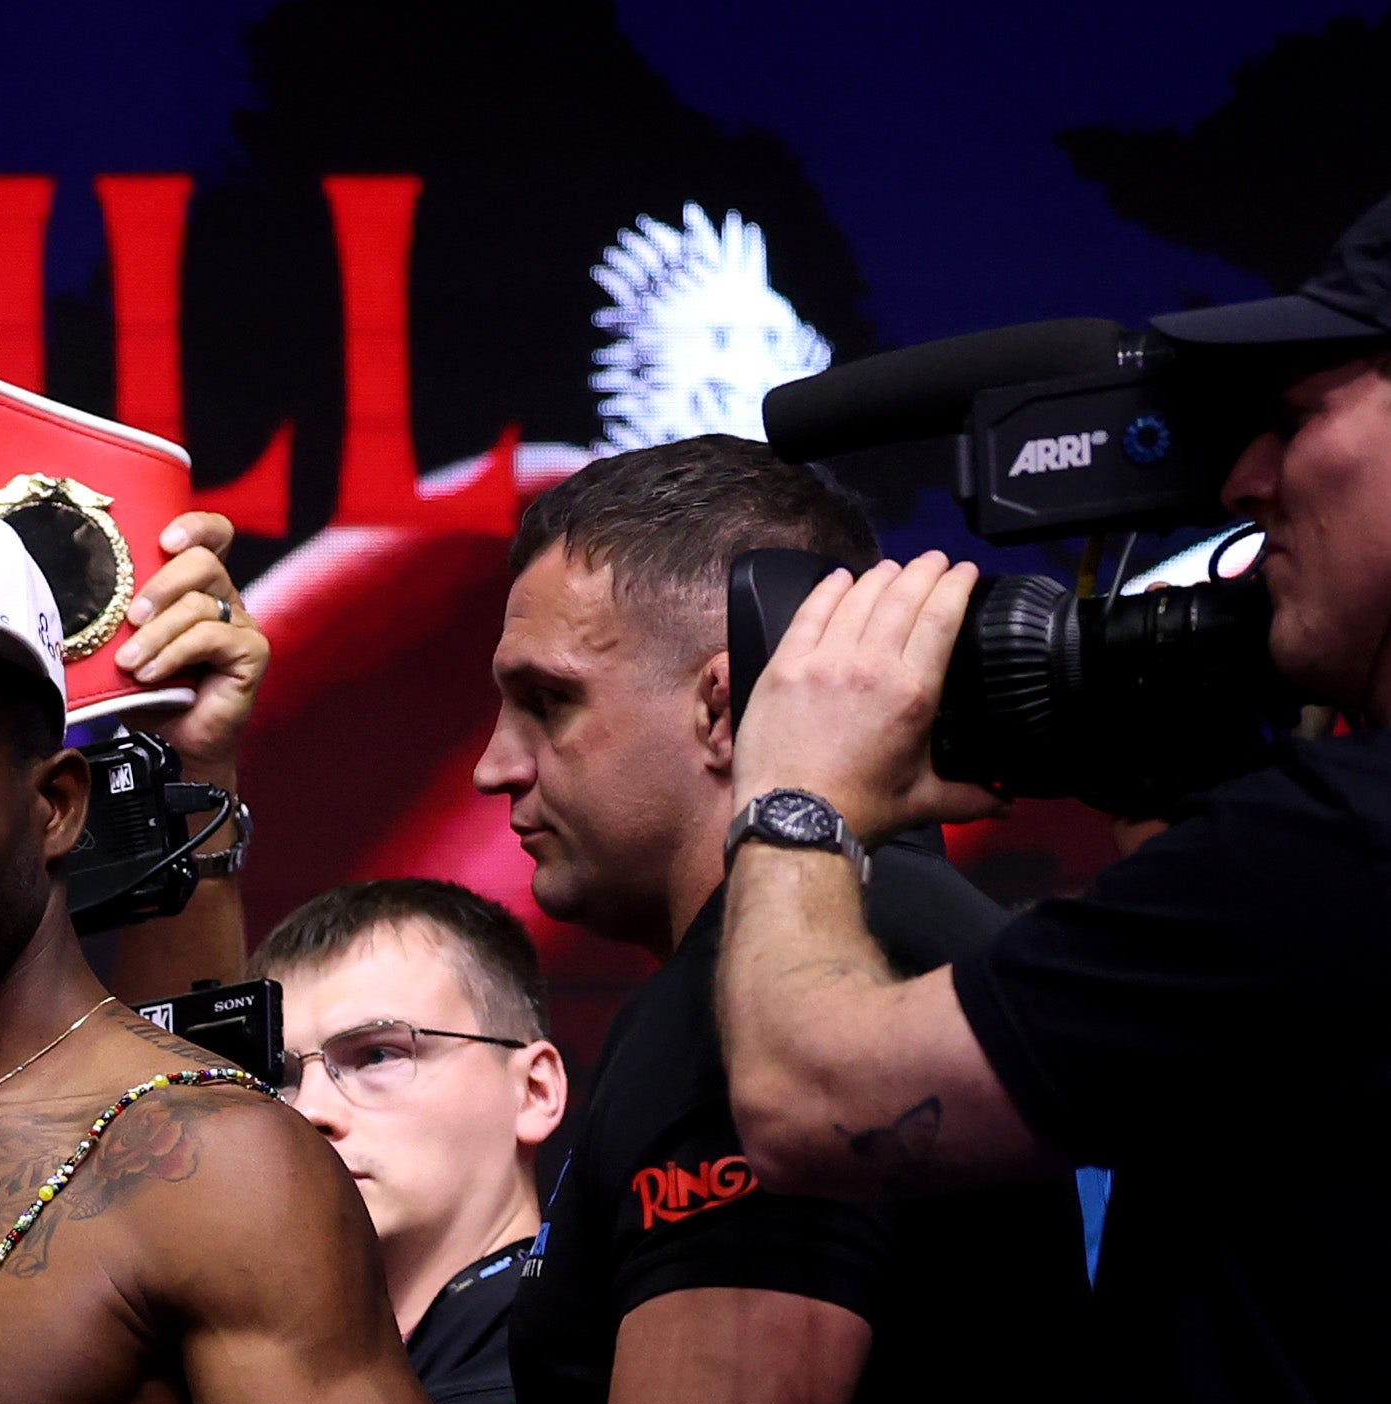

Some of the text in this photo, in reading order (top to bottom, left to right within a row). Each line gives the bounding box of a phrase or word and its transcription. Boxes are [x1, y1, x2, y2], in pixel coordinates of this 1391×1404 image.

[1008, 432, 1092, 477] ARRI
[214, 995, 255, 1013] SONY
[631, 1155, 759, 1230] RING
